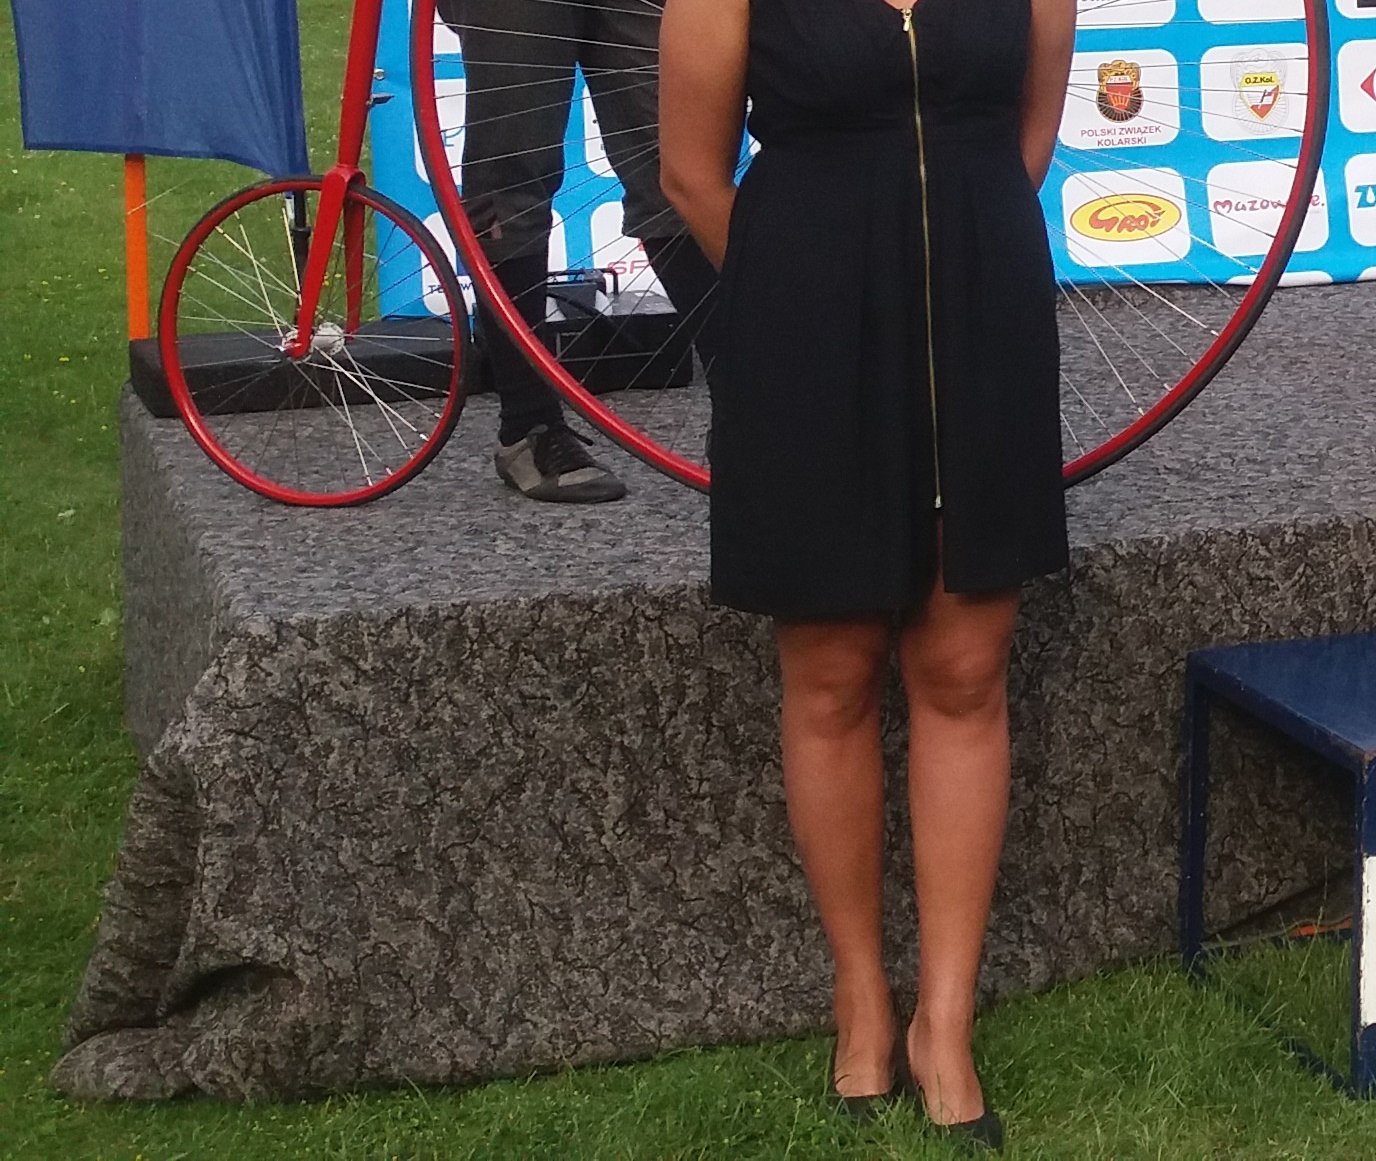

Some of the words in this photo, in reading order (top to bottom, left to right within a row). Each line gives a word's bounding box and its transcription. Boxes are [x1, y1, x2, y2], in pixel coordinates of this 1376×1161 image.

[1080, 128, 1117, 137] POLSKI
[1118, 125, 1162, 136] ZWIĄZEK
[1097, 136, 1148, 147] KOLARSKI
